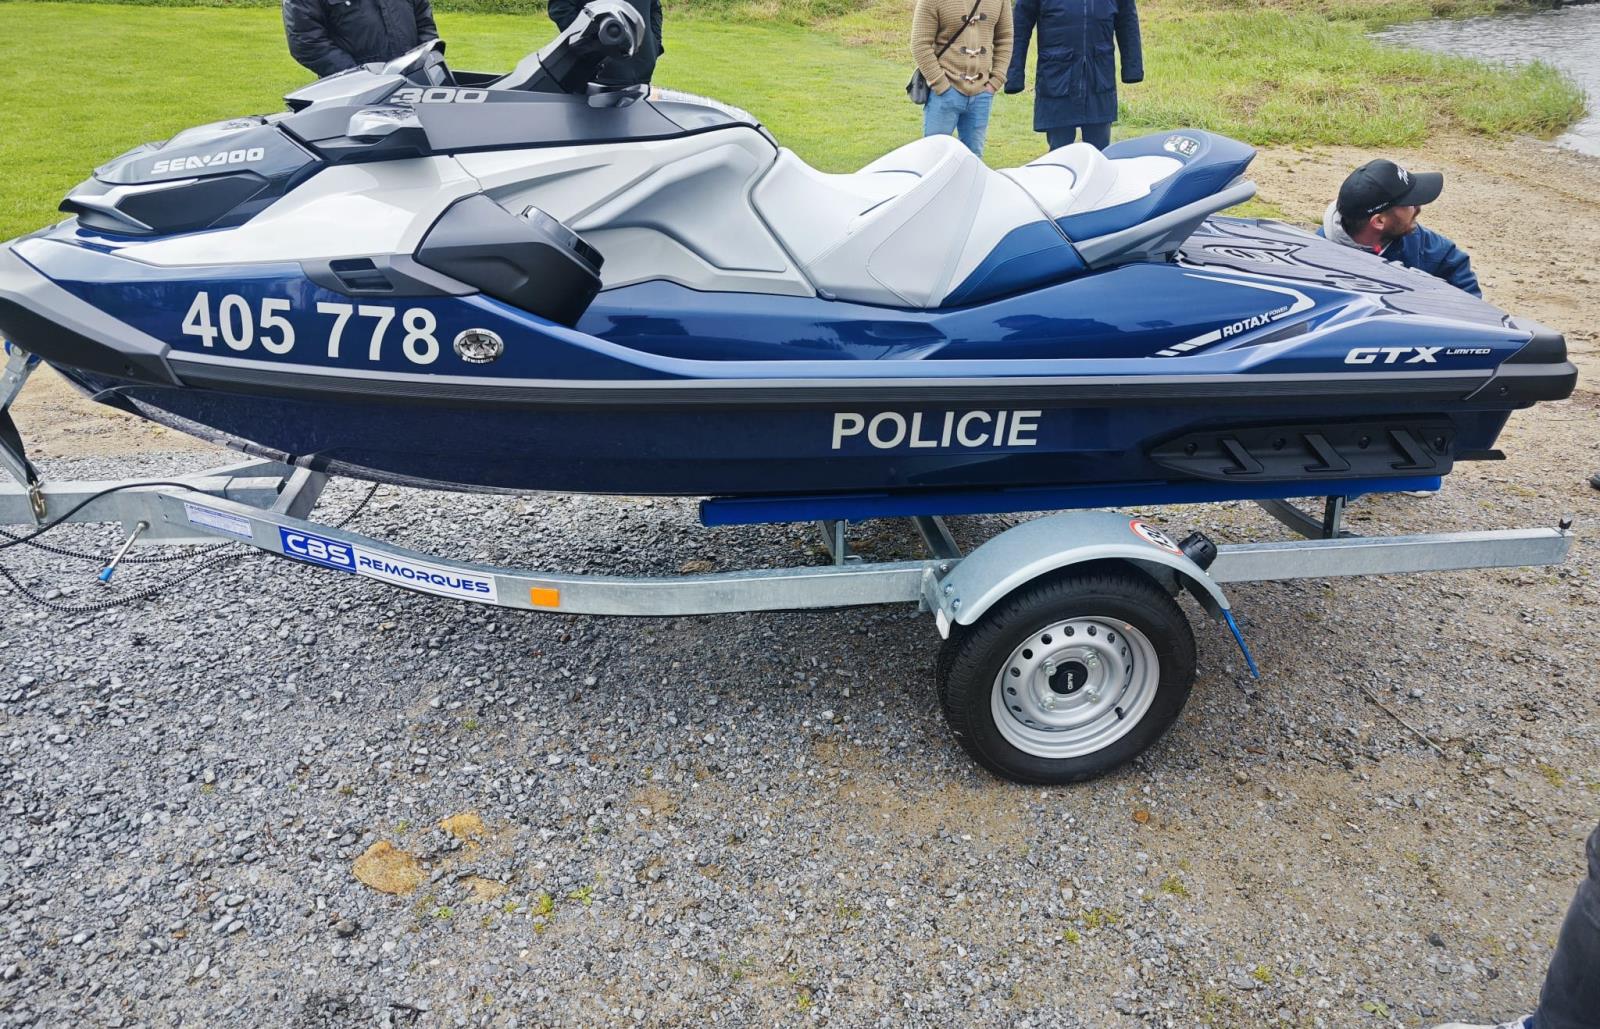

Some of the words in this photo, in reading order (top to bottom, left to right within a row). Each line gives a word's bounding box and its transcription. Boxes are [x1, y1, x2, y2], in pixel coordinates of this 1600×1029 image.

[390, 87, 489, 104] 300
[181, 291, 296, 355] 405
[316, 301, 440, 365] 778
[1222, 312, 1271, 338] ROTAX
[1268, 305, 1288, 316] POWER
[1344, 346, 1444, 364] GTX
[831, 410, 1042, 449] POLICIE
[286, 534, 350, 565] CBS
[359, 556, 490, 594] REMORQUES
